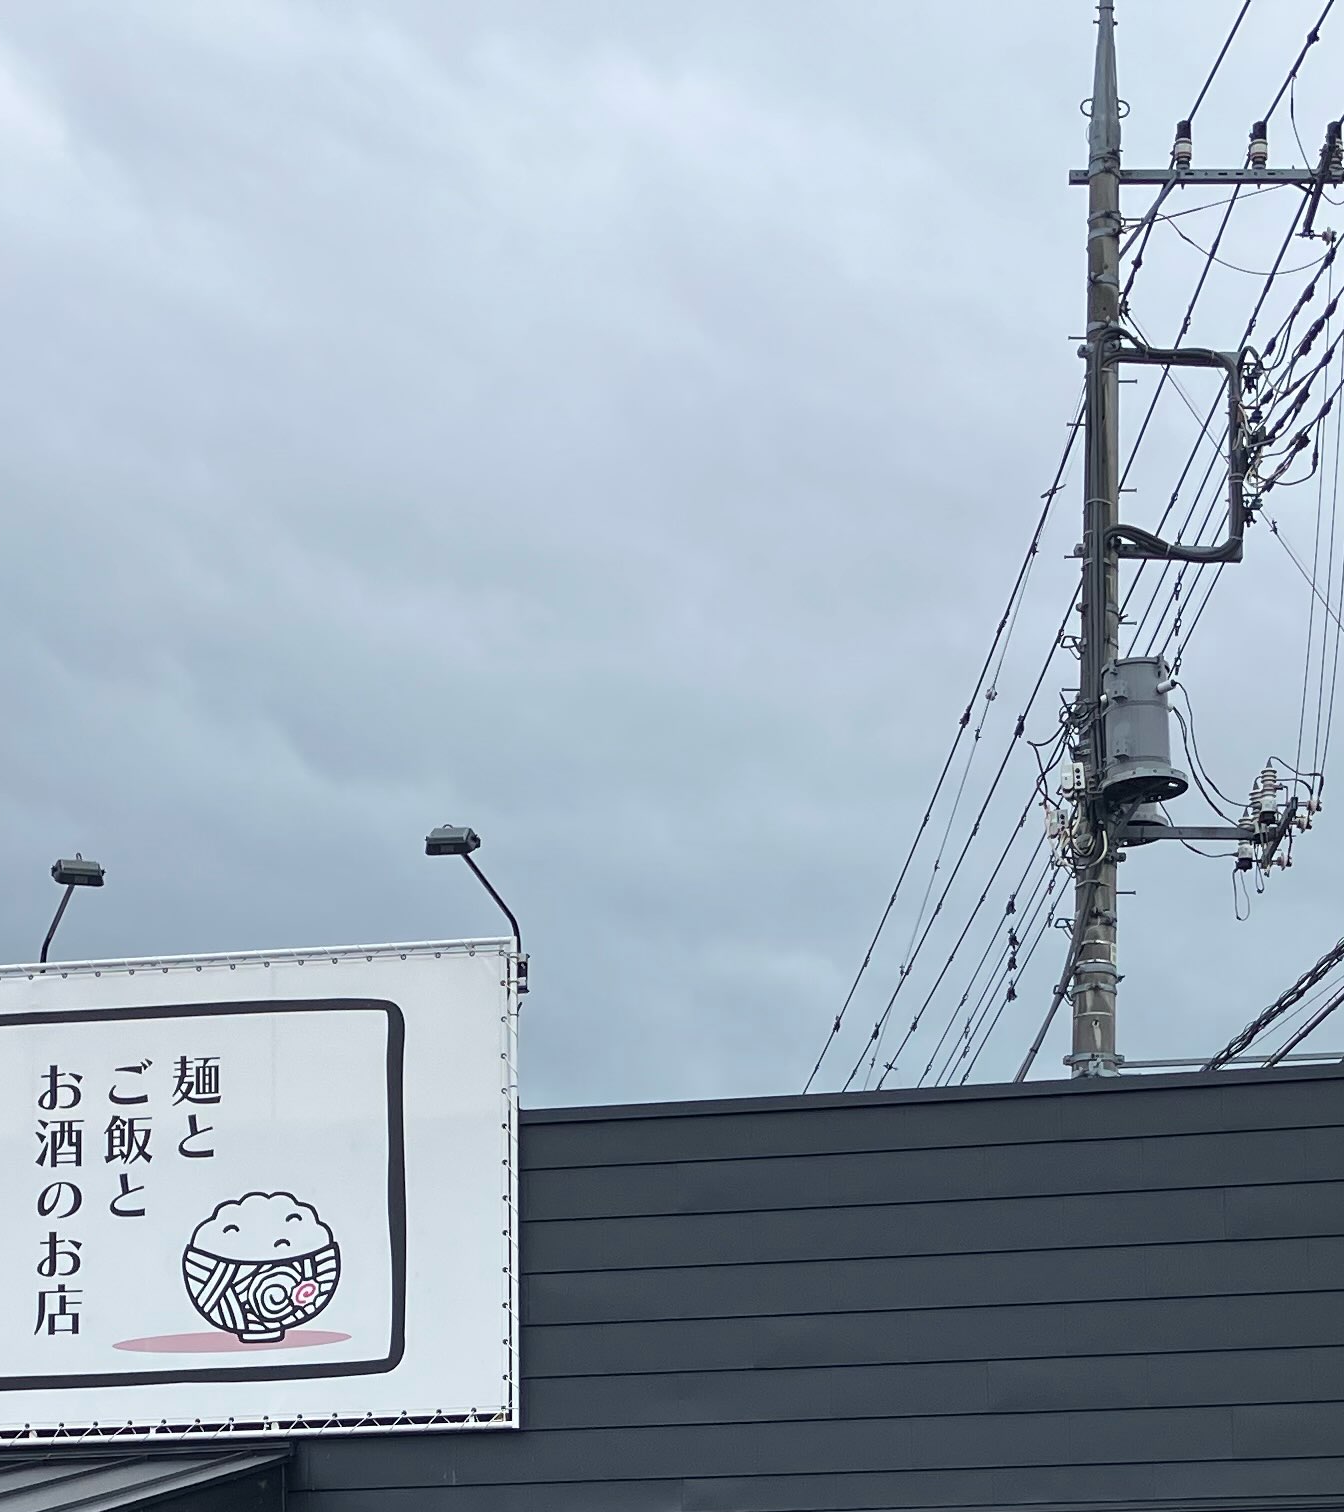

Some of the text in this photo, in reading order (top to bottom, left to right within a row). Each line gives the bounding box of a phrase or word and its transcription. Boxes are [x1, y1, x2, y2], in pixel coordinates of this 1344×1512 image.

[105, 1058, 154, 1219] ご飯と
[172, 1053, 223, 1160] 麺と
[34, 1064, 85, 1337] お酒のお店
